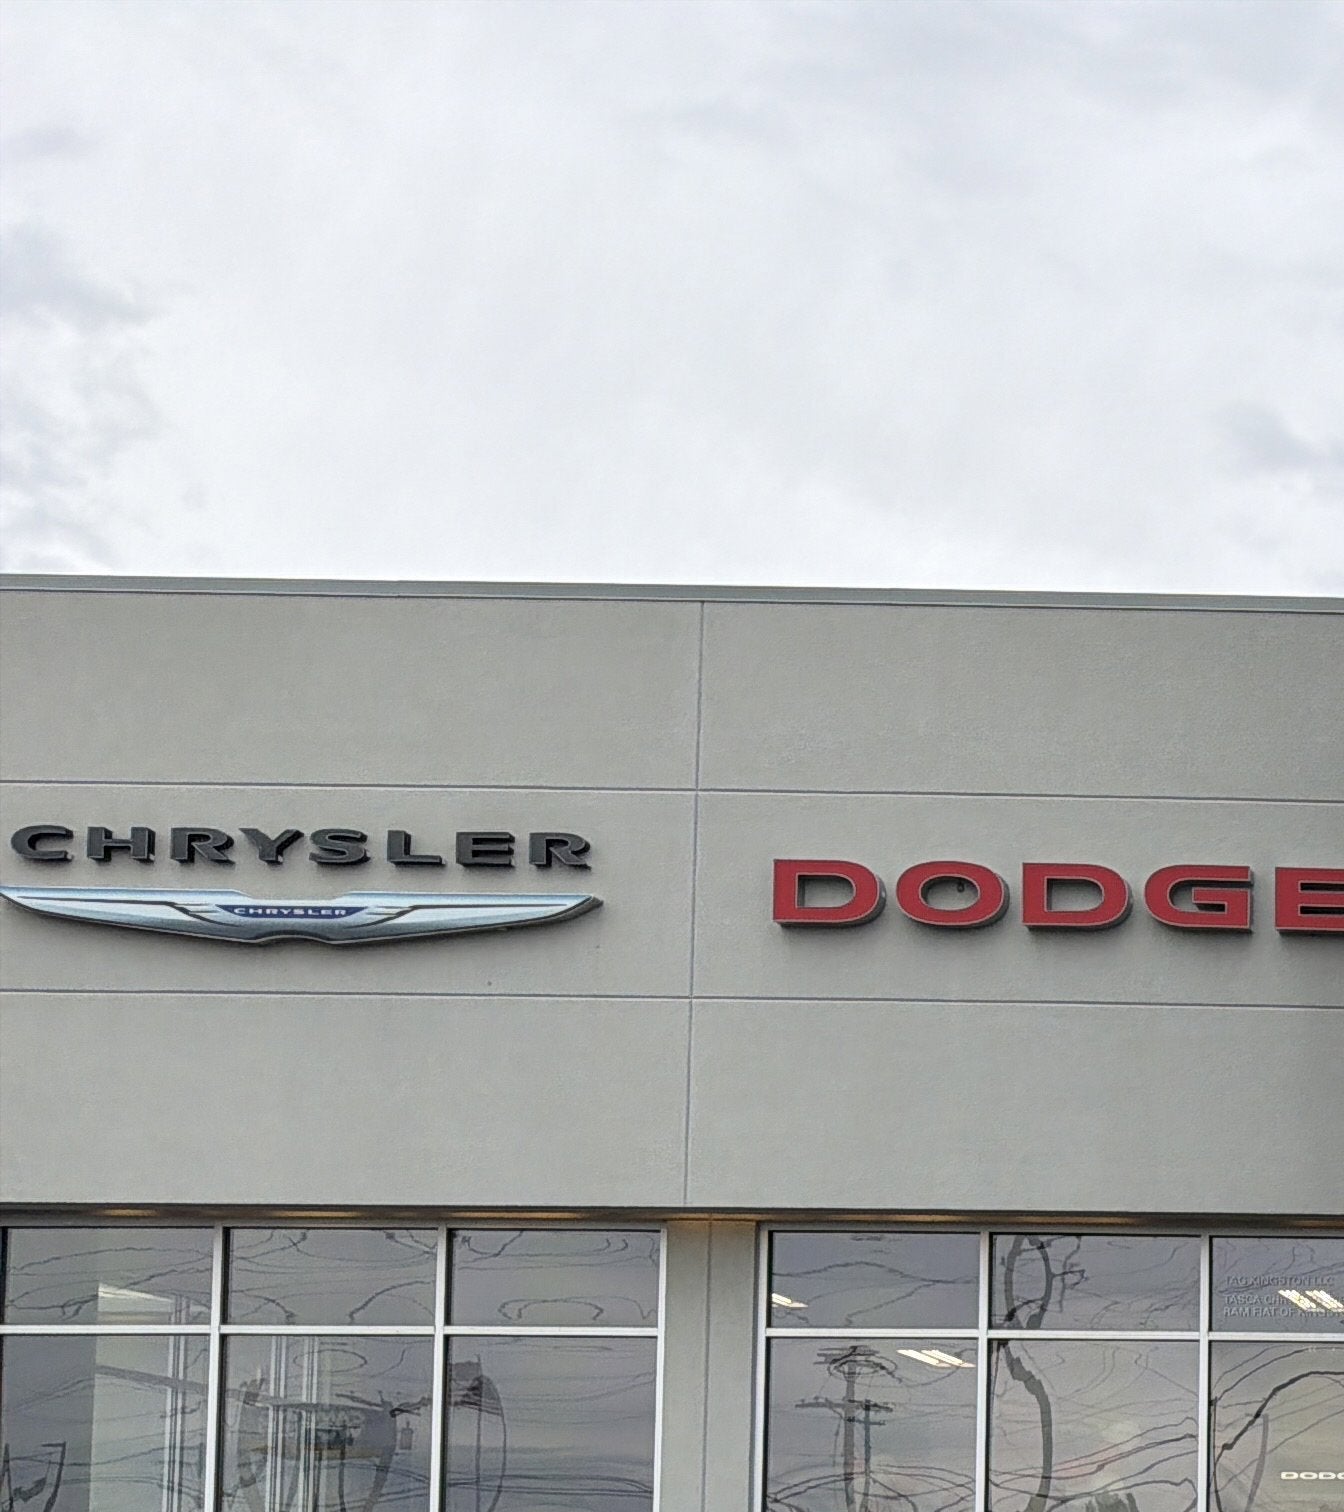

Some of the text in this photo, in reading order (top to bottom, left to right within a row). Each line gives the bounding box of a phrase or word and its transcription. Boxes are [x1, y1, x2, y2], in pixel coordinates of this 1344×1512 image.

[11, 824, 593, 870] CHRYSLER
[233, 907, 347, 916] CHRYSLER
[1314, 1275, 1336, 1286] LLC
[1223, 1306, 1252, 1317] RAM
